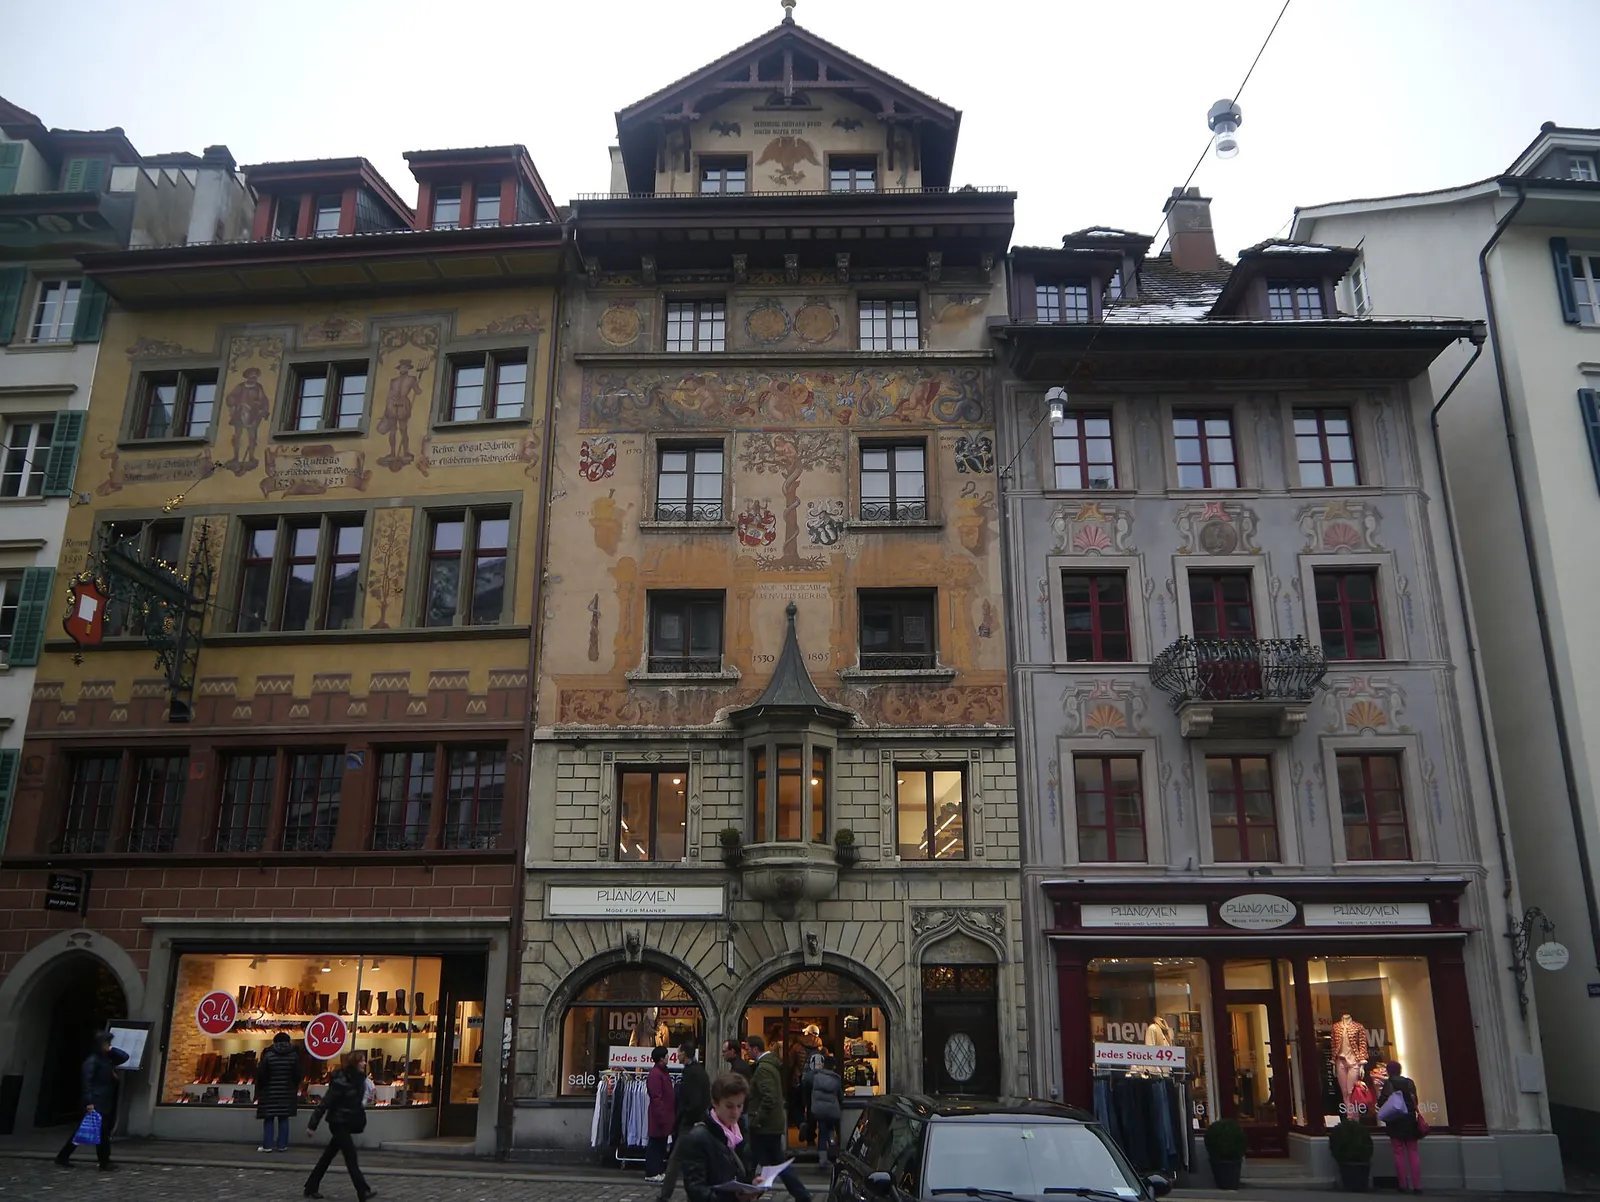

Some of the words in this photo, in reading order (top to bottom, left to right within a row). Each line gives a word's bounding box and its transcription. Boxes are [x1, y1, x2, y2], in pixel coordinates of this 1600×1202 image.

[752, 654, 775, 664] 1530
[808, 653, 830, 662] 1895
[597, 888, 676, 904] PHÄNOMEN
[200, 999, 231, 1024] Sale
[309, 1020, 342, 1048] Sale
[610, 1053, 638, 1063] Jedes
[1096, 1050, 1124, 1059] Jedes
[1127, 1051, 1153, 1061] Stück
[568, 1071, 596, 1085] sale
[1338, 1101, 1367, 1114] sale
